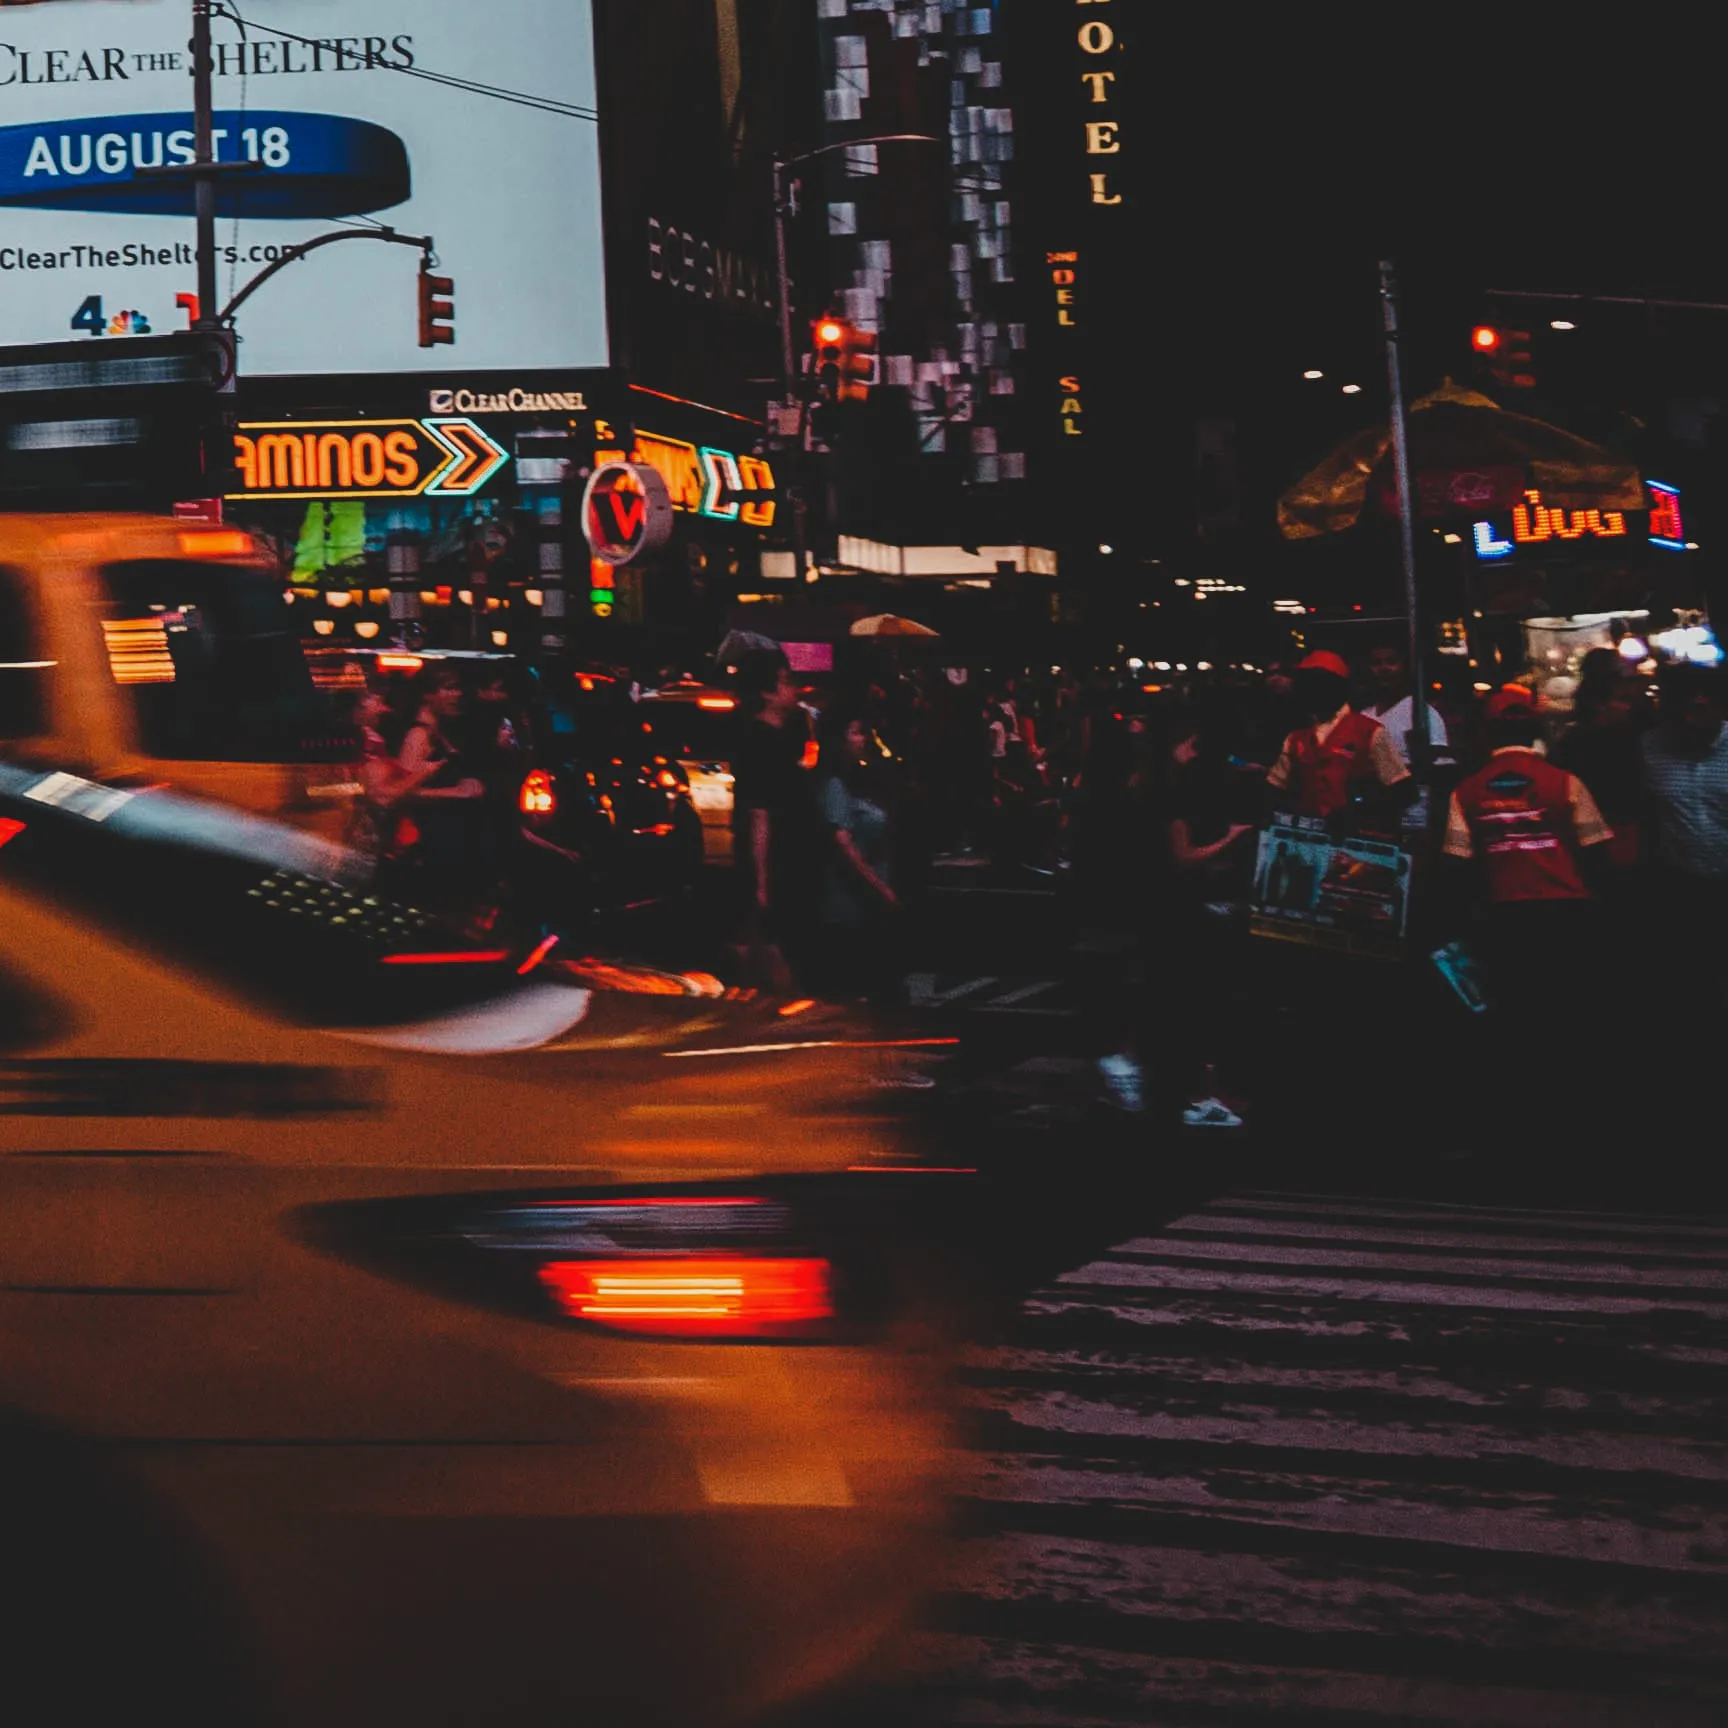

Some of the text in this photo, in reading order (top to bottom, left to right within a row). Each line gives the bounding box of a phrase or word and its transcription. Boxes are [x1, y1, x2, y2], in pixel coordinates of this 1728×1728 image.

[132, 52, 183, 71] THE
[187, 35, 415, 77] SHELTERS
[23, 126, 290, 177] AUGUST 18
[0, 242, 306, 271] ClearTheSheltrs.com
[71, 294, 107, 336] 4
